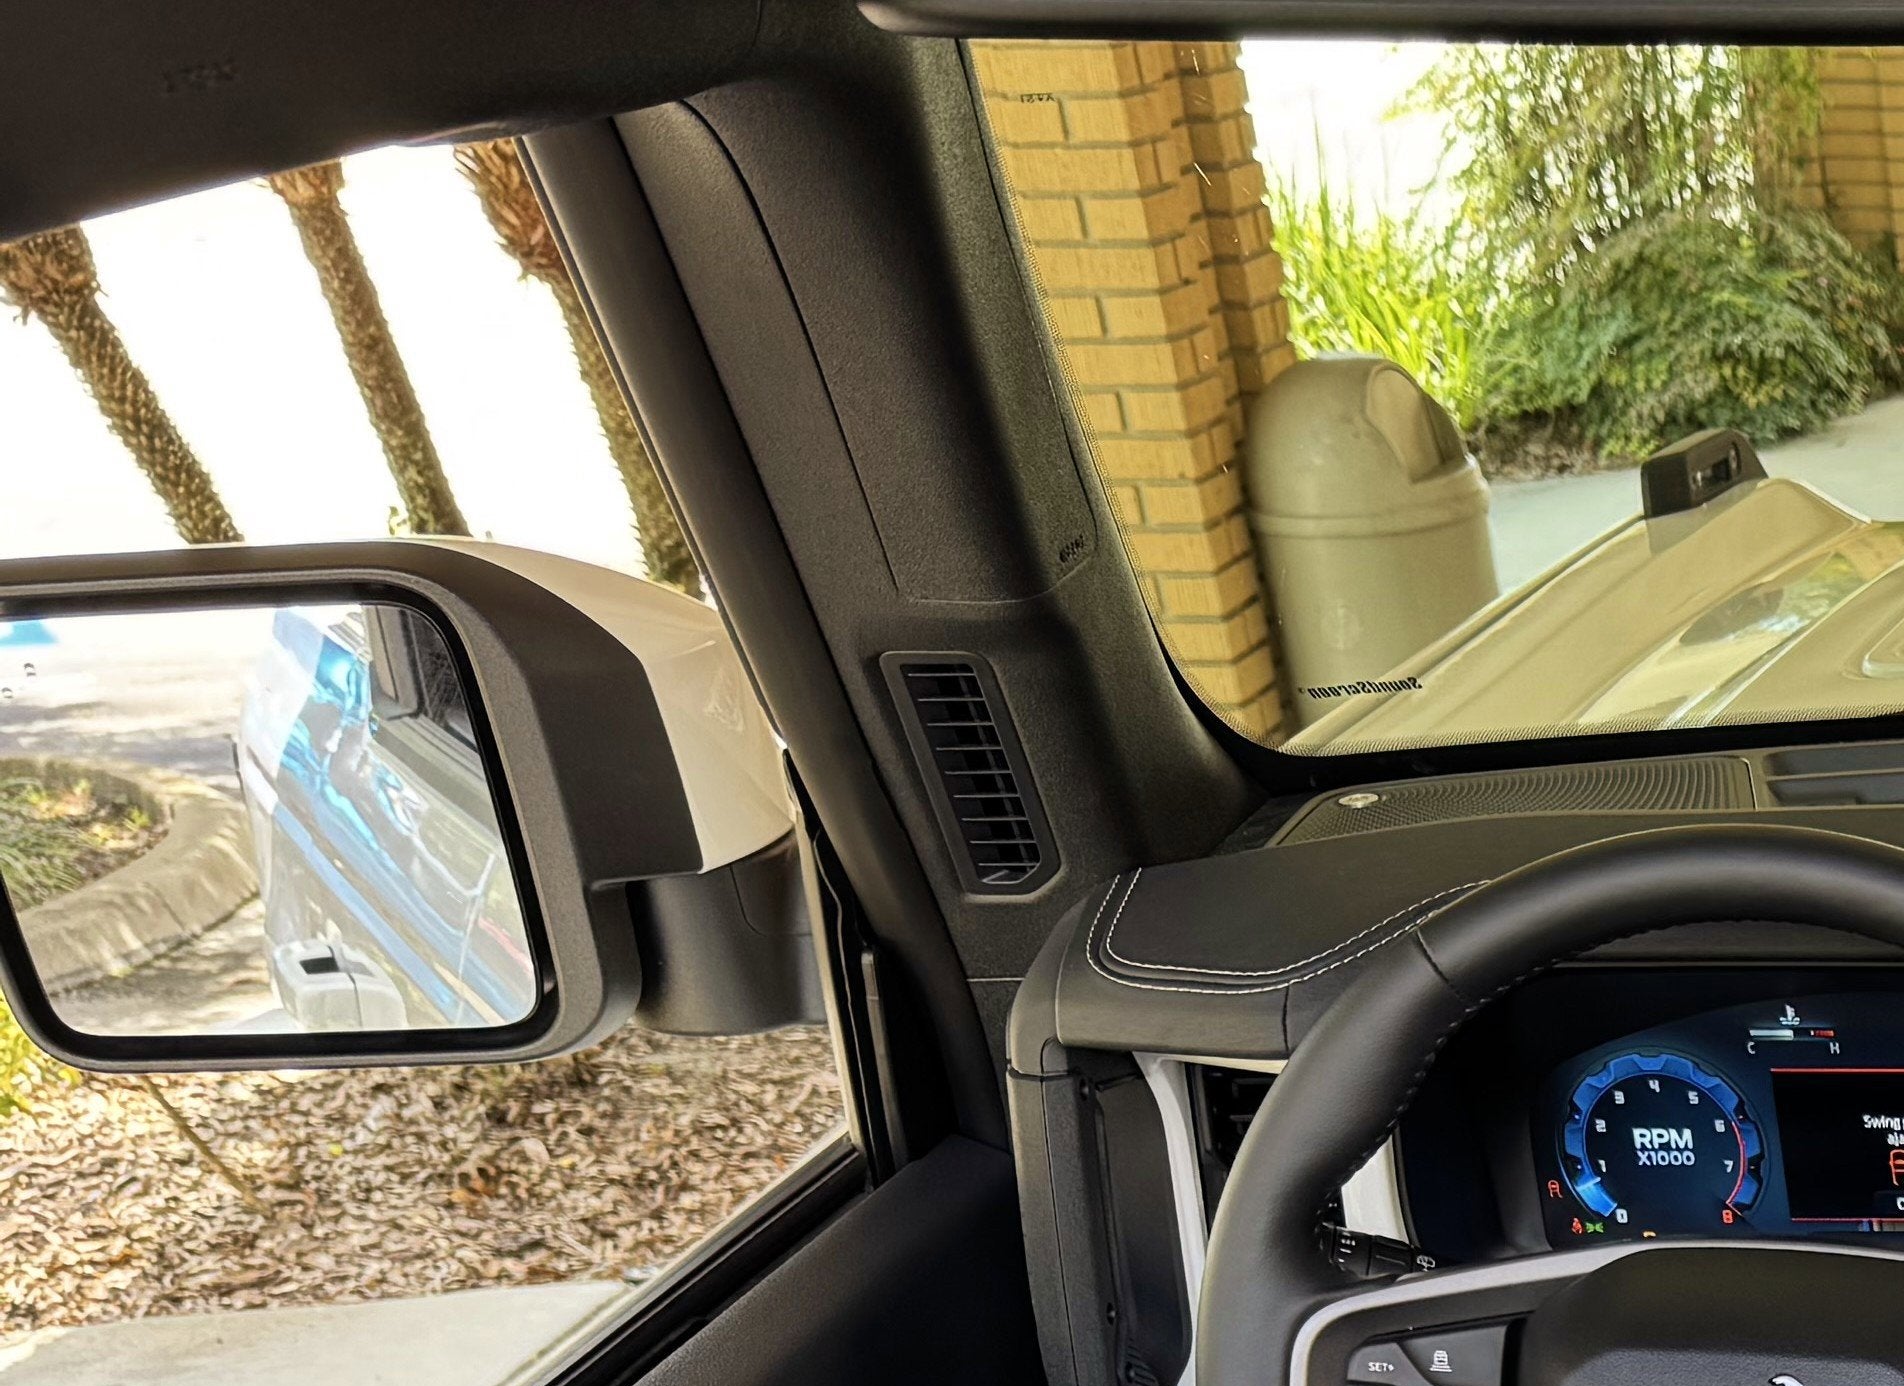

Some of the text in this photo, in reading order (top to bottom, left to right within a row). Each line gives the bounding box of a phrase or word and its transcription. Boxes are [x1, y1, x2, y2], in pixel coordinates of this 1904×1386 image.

[1829, 1042, 1841, 1055] H
[1649, 1080, 1660, 1093] 4
[1615, 1091, 1625, 1104] 3
[1689, 1091, 1699, 1104] 5
[1596, 1119, 1606, 1133] 2
[1715, 1120, 1725, 1132] 6
[1862, 1114, 1901, 1131] Swing
[1632, 1127, 1694, 1149] RPM
[1637, 1150, 1696, 1166] X1000
[1598, 1159, 1607, 1173] 1
[1723, 1160, 1734, 1173] 7
[1616, 1208, 1629, 1224] 0
[1723, 1210, 1733, 1223] 8
